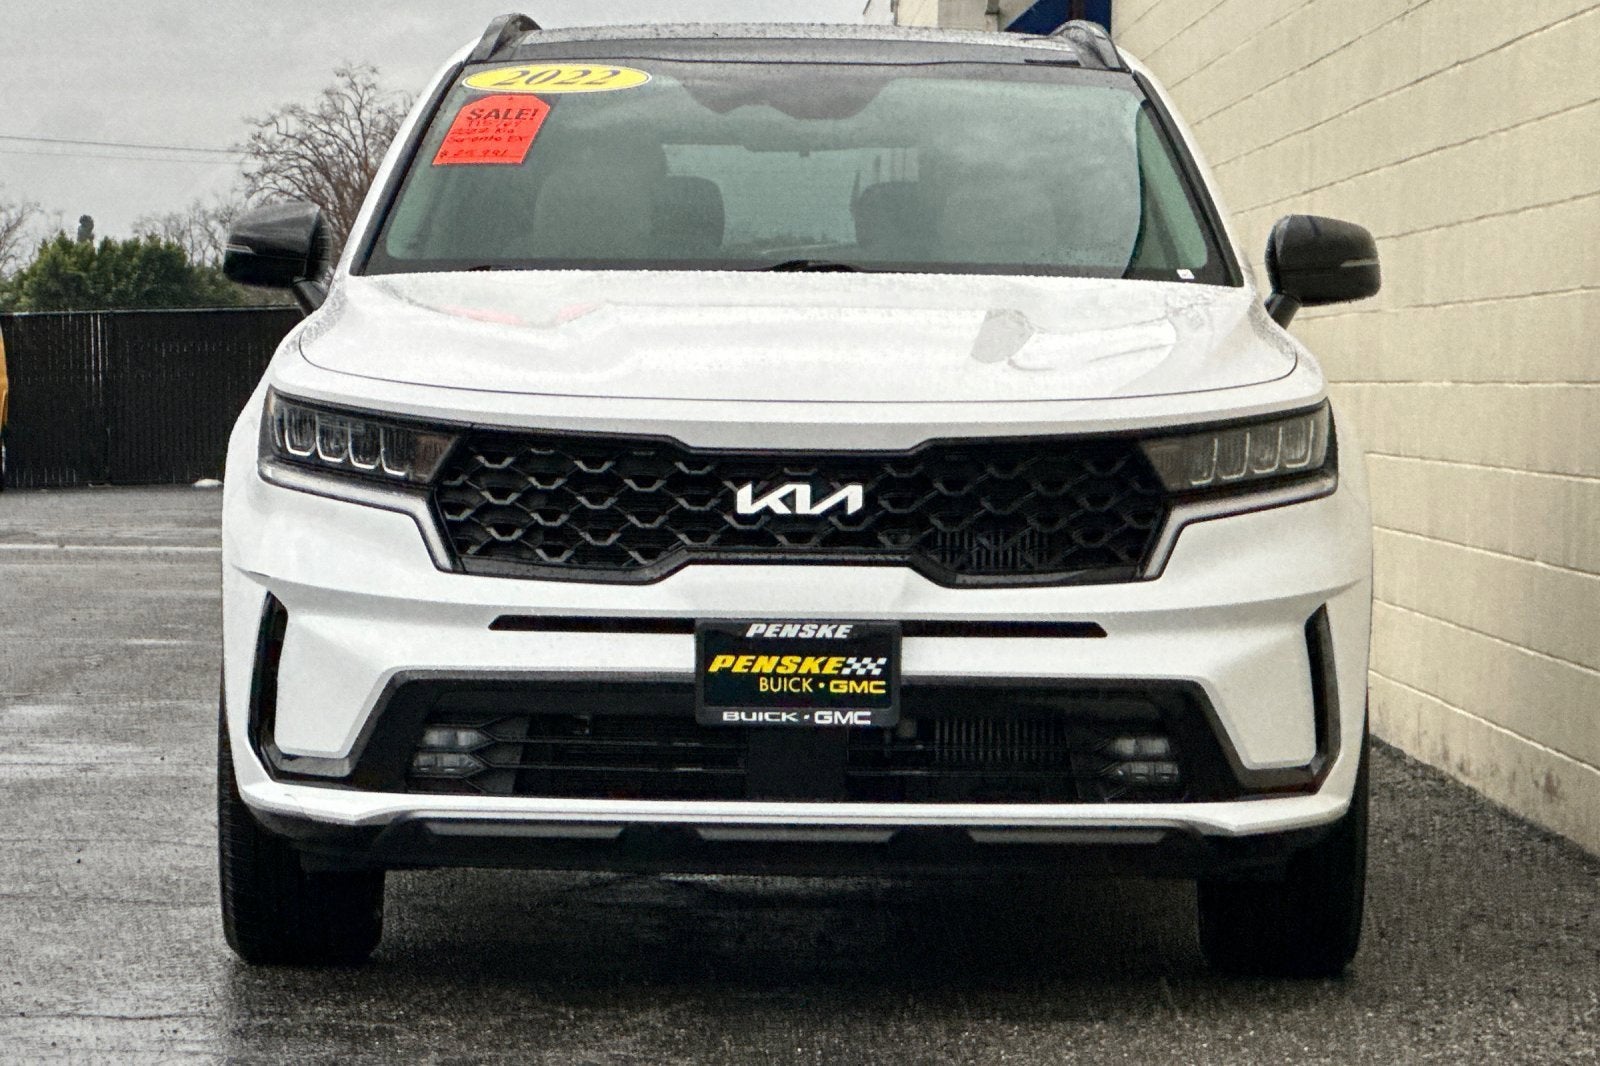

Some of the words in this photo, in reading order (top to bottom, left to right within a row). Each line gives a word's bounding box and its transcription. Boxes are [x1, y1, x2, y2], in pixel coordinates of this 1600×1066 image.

[491, 69, 621, 87] 2022
[466, 108, 539, 121] SALE!
[736, 482, 863, 515] KIA
[745, 623, 854, 639] PENSKE
[708, 655, 847, 675] PENSKE
[759, 677, 813, 692] BUICK
[829, 680, 886, 694] GMC
[722, 711, 799, 722] BUICK
[814, 711, 872, 725] GMC
